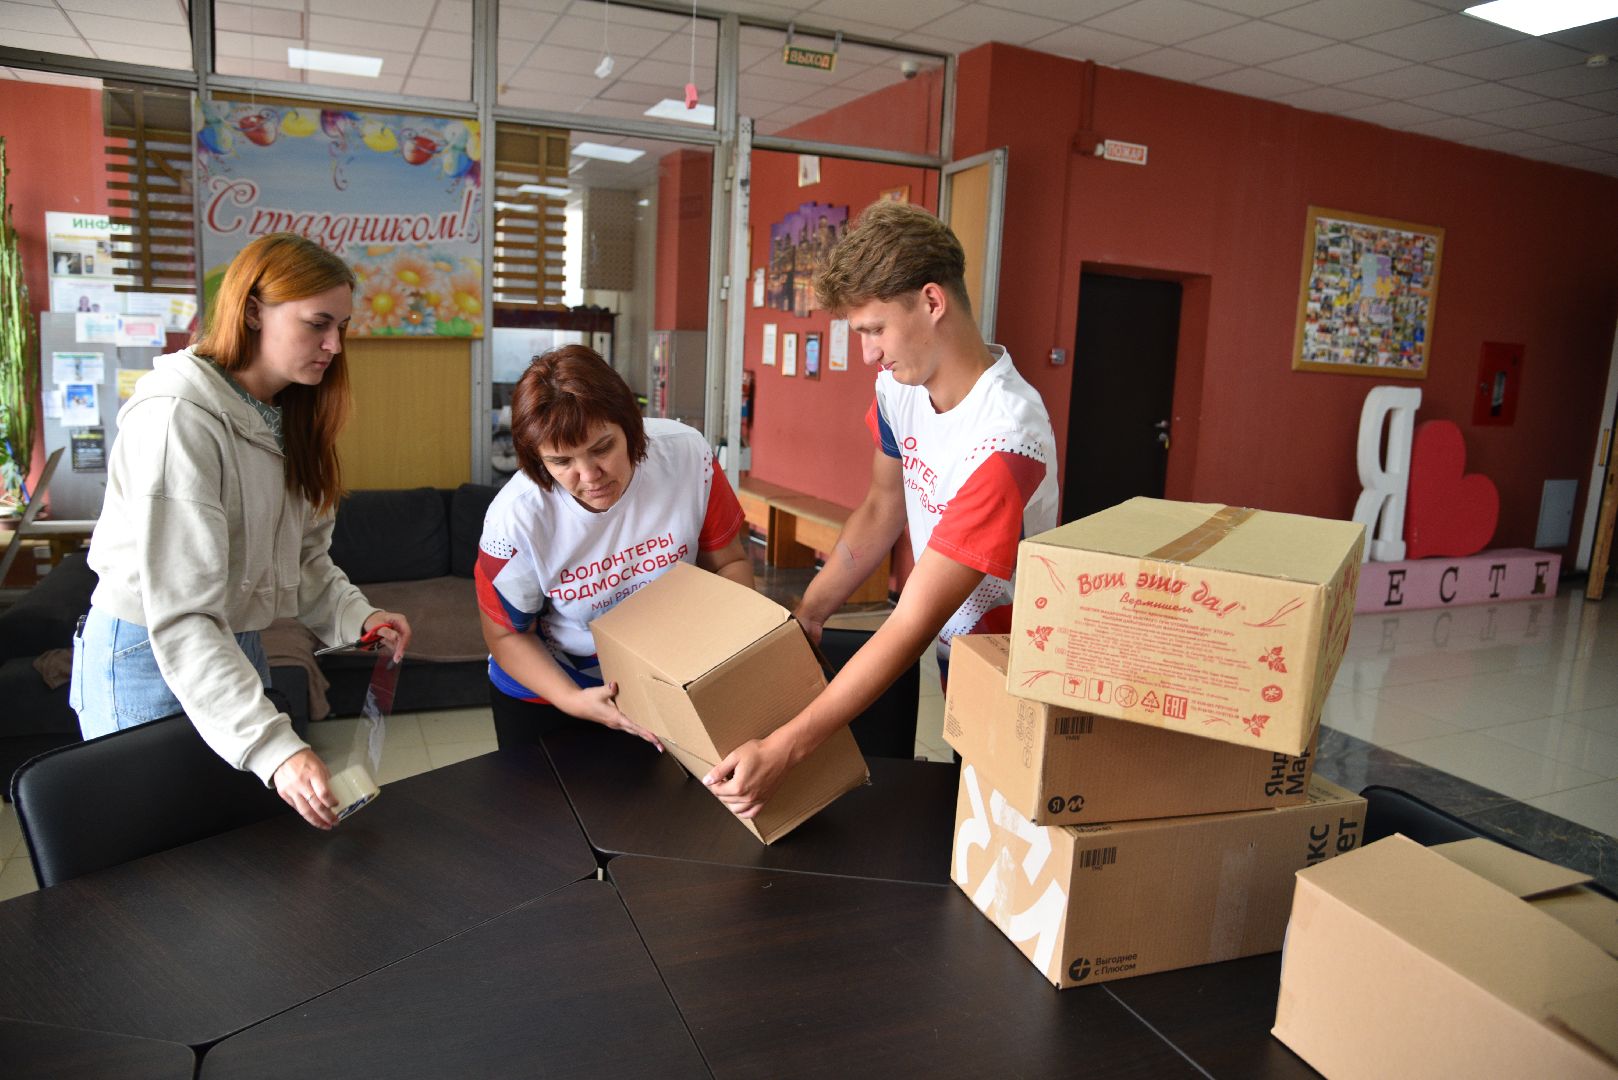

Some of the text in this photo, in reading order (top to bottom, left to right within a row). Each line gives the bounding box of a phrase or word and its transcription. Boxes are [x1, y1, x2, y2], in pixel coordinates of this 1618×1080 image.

[790, 50, 830, 68] ВЫХОД
[1107, 143, 1145, 161] ПОЖАР
[207, 179, 257, 233] С
[560, 533, 674, 584] ВОЛОНТЕРЫ
[549, 544, 688, 601] ПОДМОСКОВЬЯ
[1078, 572, 1125, 595] Вот
[1136, 572, 1187, 593] это
[592, 596, 613, 610] МЫ
